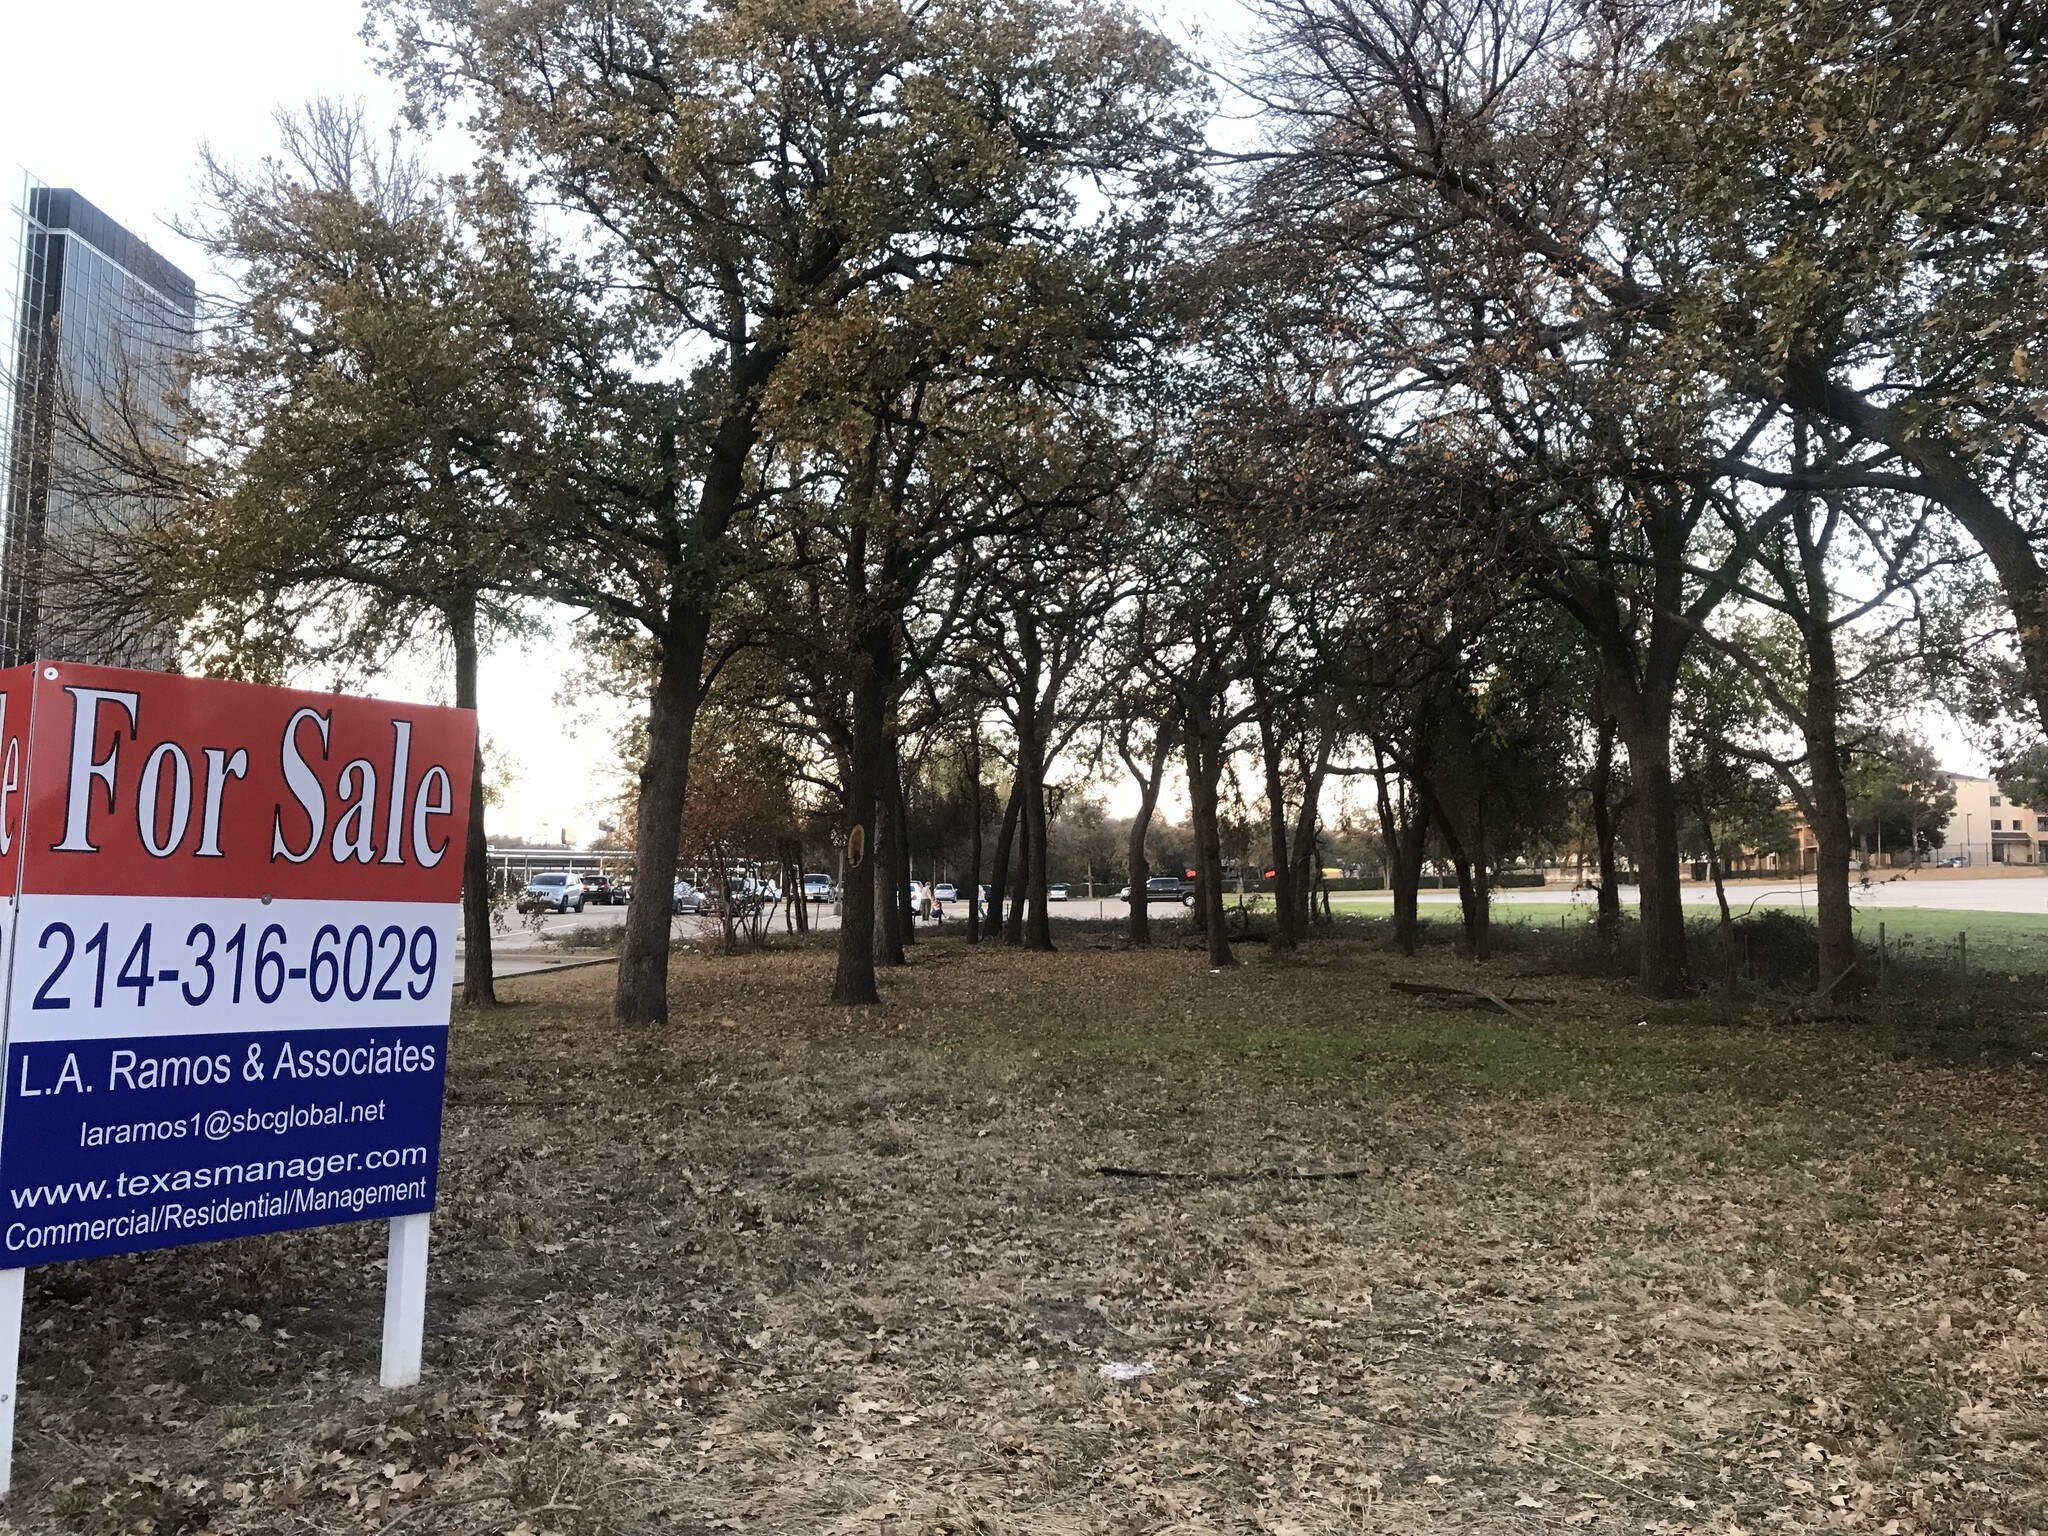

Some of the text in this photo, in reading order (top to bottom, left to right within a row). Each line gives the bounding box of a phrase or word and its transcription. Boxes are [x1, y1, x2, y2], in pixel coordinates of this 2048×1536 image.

[51, 686, 453, 868] For Sale
[32, 922, 437, 1010] 214-316-6029
[19, 1038, 436, 1097] L.A. Ramos & Associates
[80, 1099, 386, 1147] laramos1@sbcglobal.net
[10, 1146, 427, 1210] www.texasmanager.com
[5, 1176, 427, 1252] Commercial/Residential/Management
